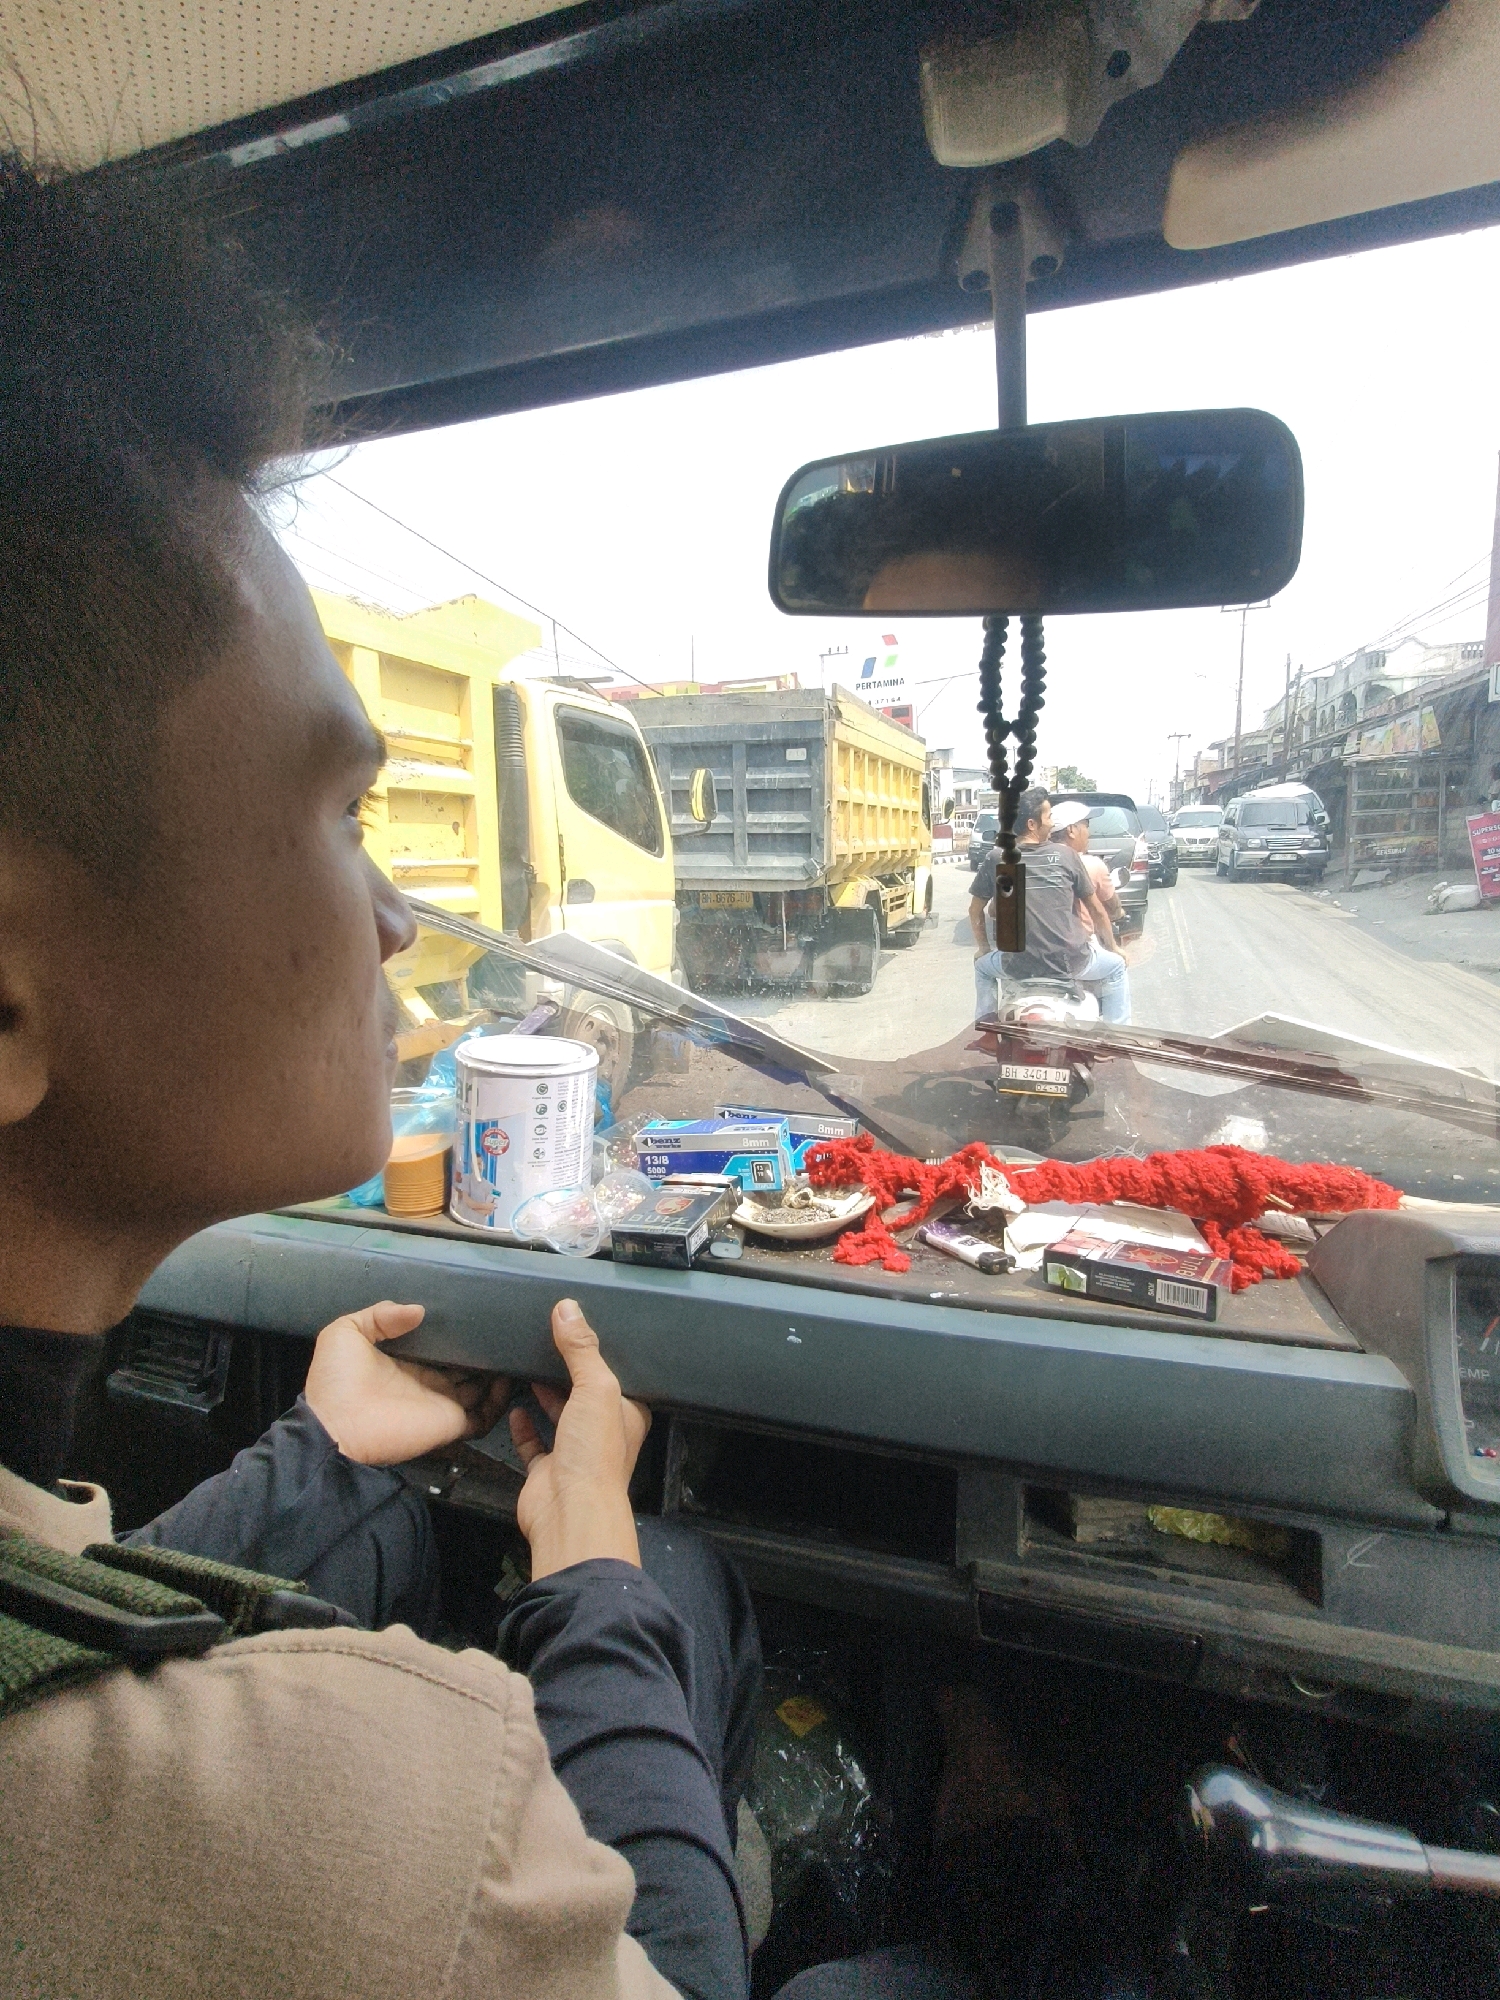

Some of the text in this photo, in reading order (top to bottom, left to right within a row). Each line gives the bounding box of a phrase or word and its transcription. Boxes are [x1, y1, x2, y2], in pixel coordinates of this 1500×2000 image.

[855, 678, 905, 691] PERTAMINA
[1005, 1067, 1018, 1078] BH
[818, 1124, 844, 1136] 8mm
[742, 1138, 769, 1147] 8mm
[645, 1156, 669, 1165] 13/8
[647, 1166, 667, 1174] 5000
[1175, 1255, 1206, 1278] BULL
[1459, 1367, 1490, 1379] EMP
